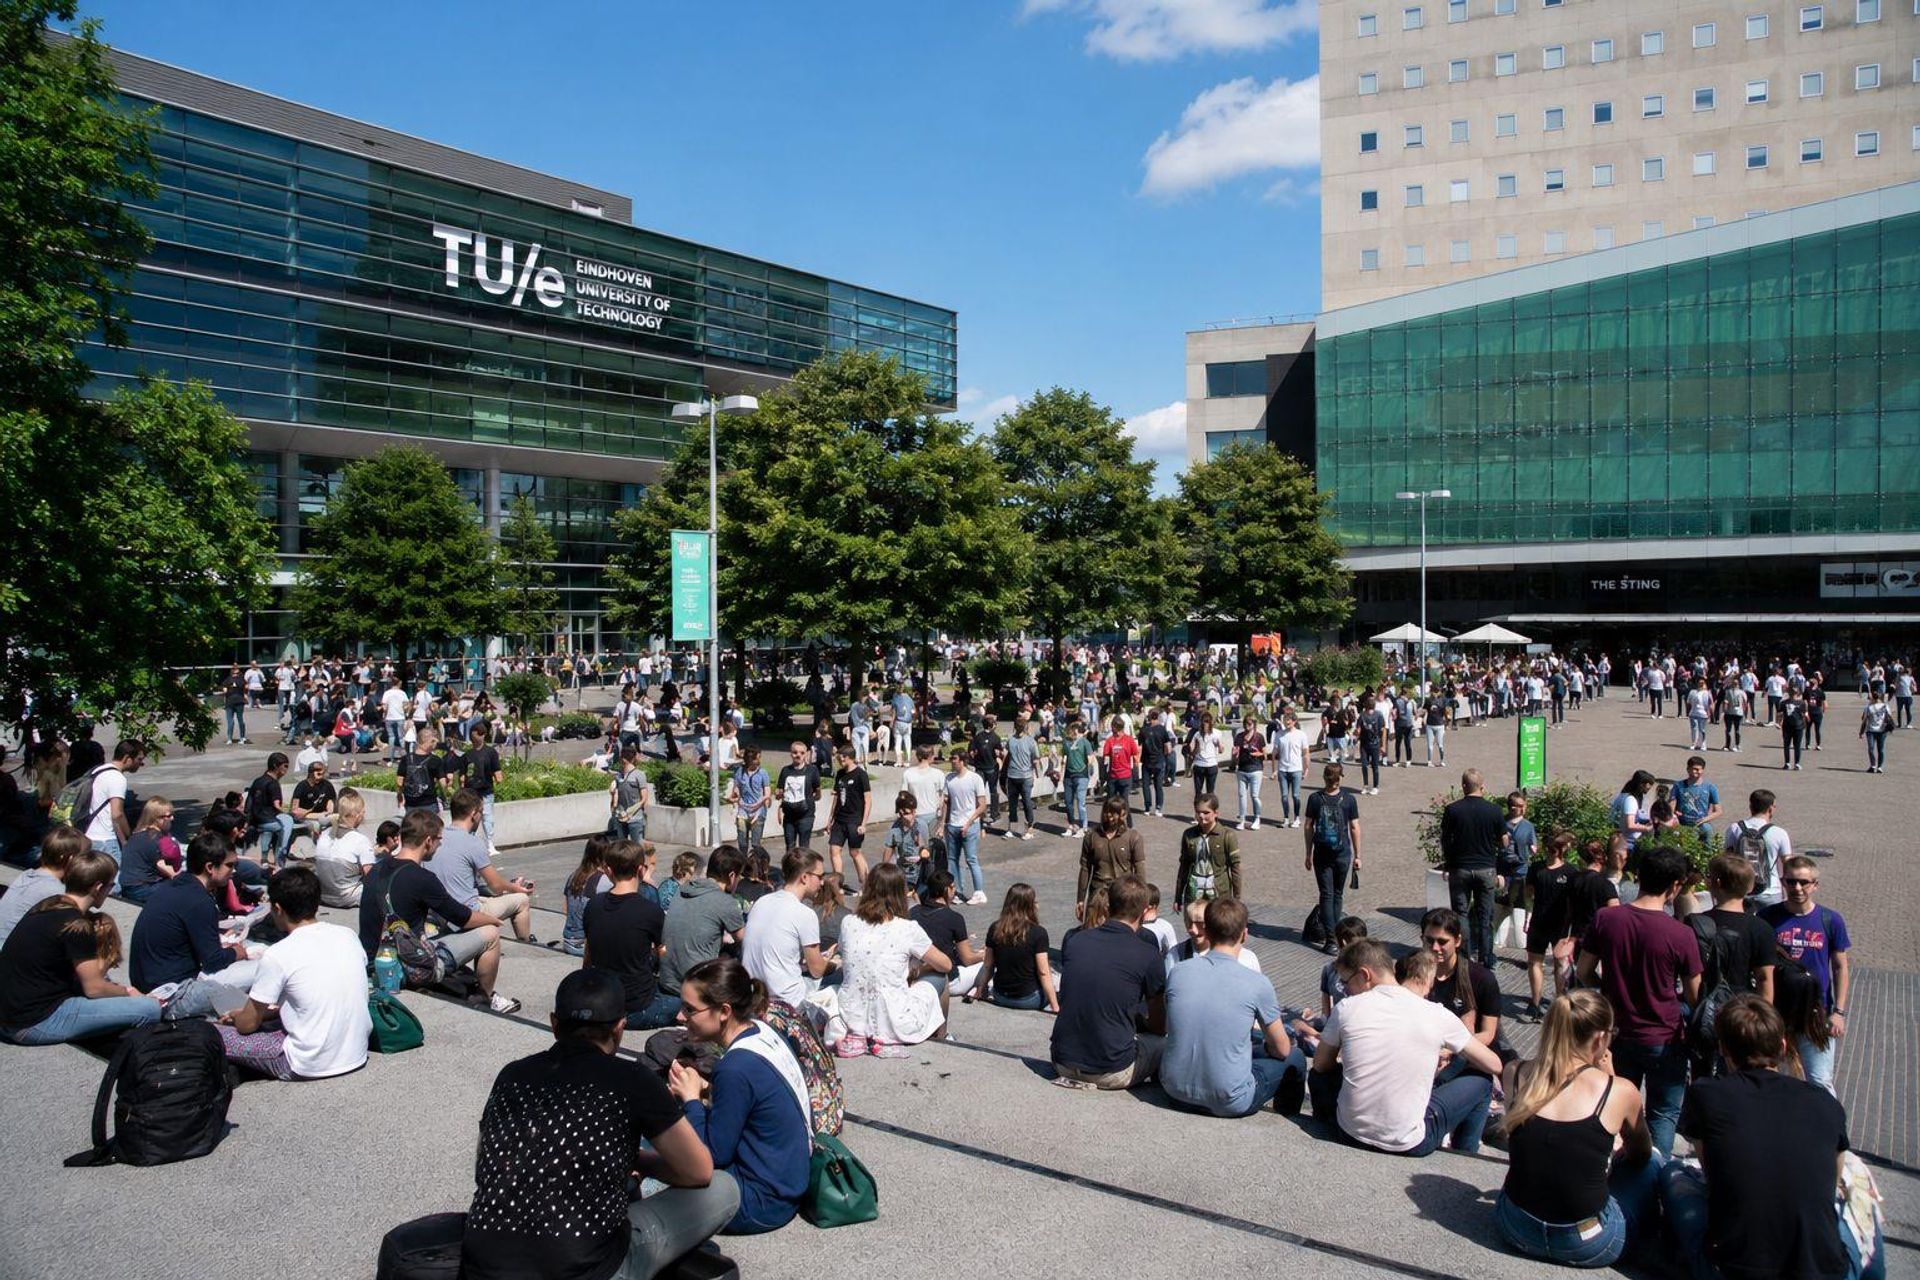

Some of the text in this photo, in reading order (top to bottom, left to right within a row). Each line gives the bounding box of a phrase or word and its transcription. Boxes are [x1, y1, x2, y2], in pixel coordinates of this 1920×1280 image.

[433, 224, 566, 308] TU/e
[576, 260, 652, 288] EINDHOVEN
[576, 279, 670, 312] UNIVERSITY OF
[576, 301, 663, 330] TECHNOLOGY
[1590, 579, 1660, 590] THE STING
